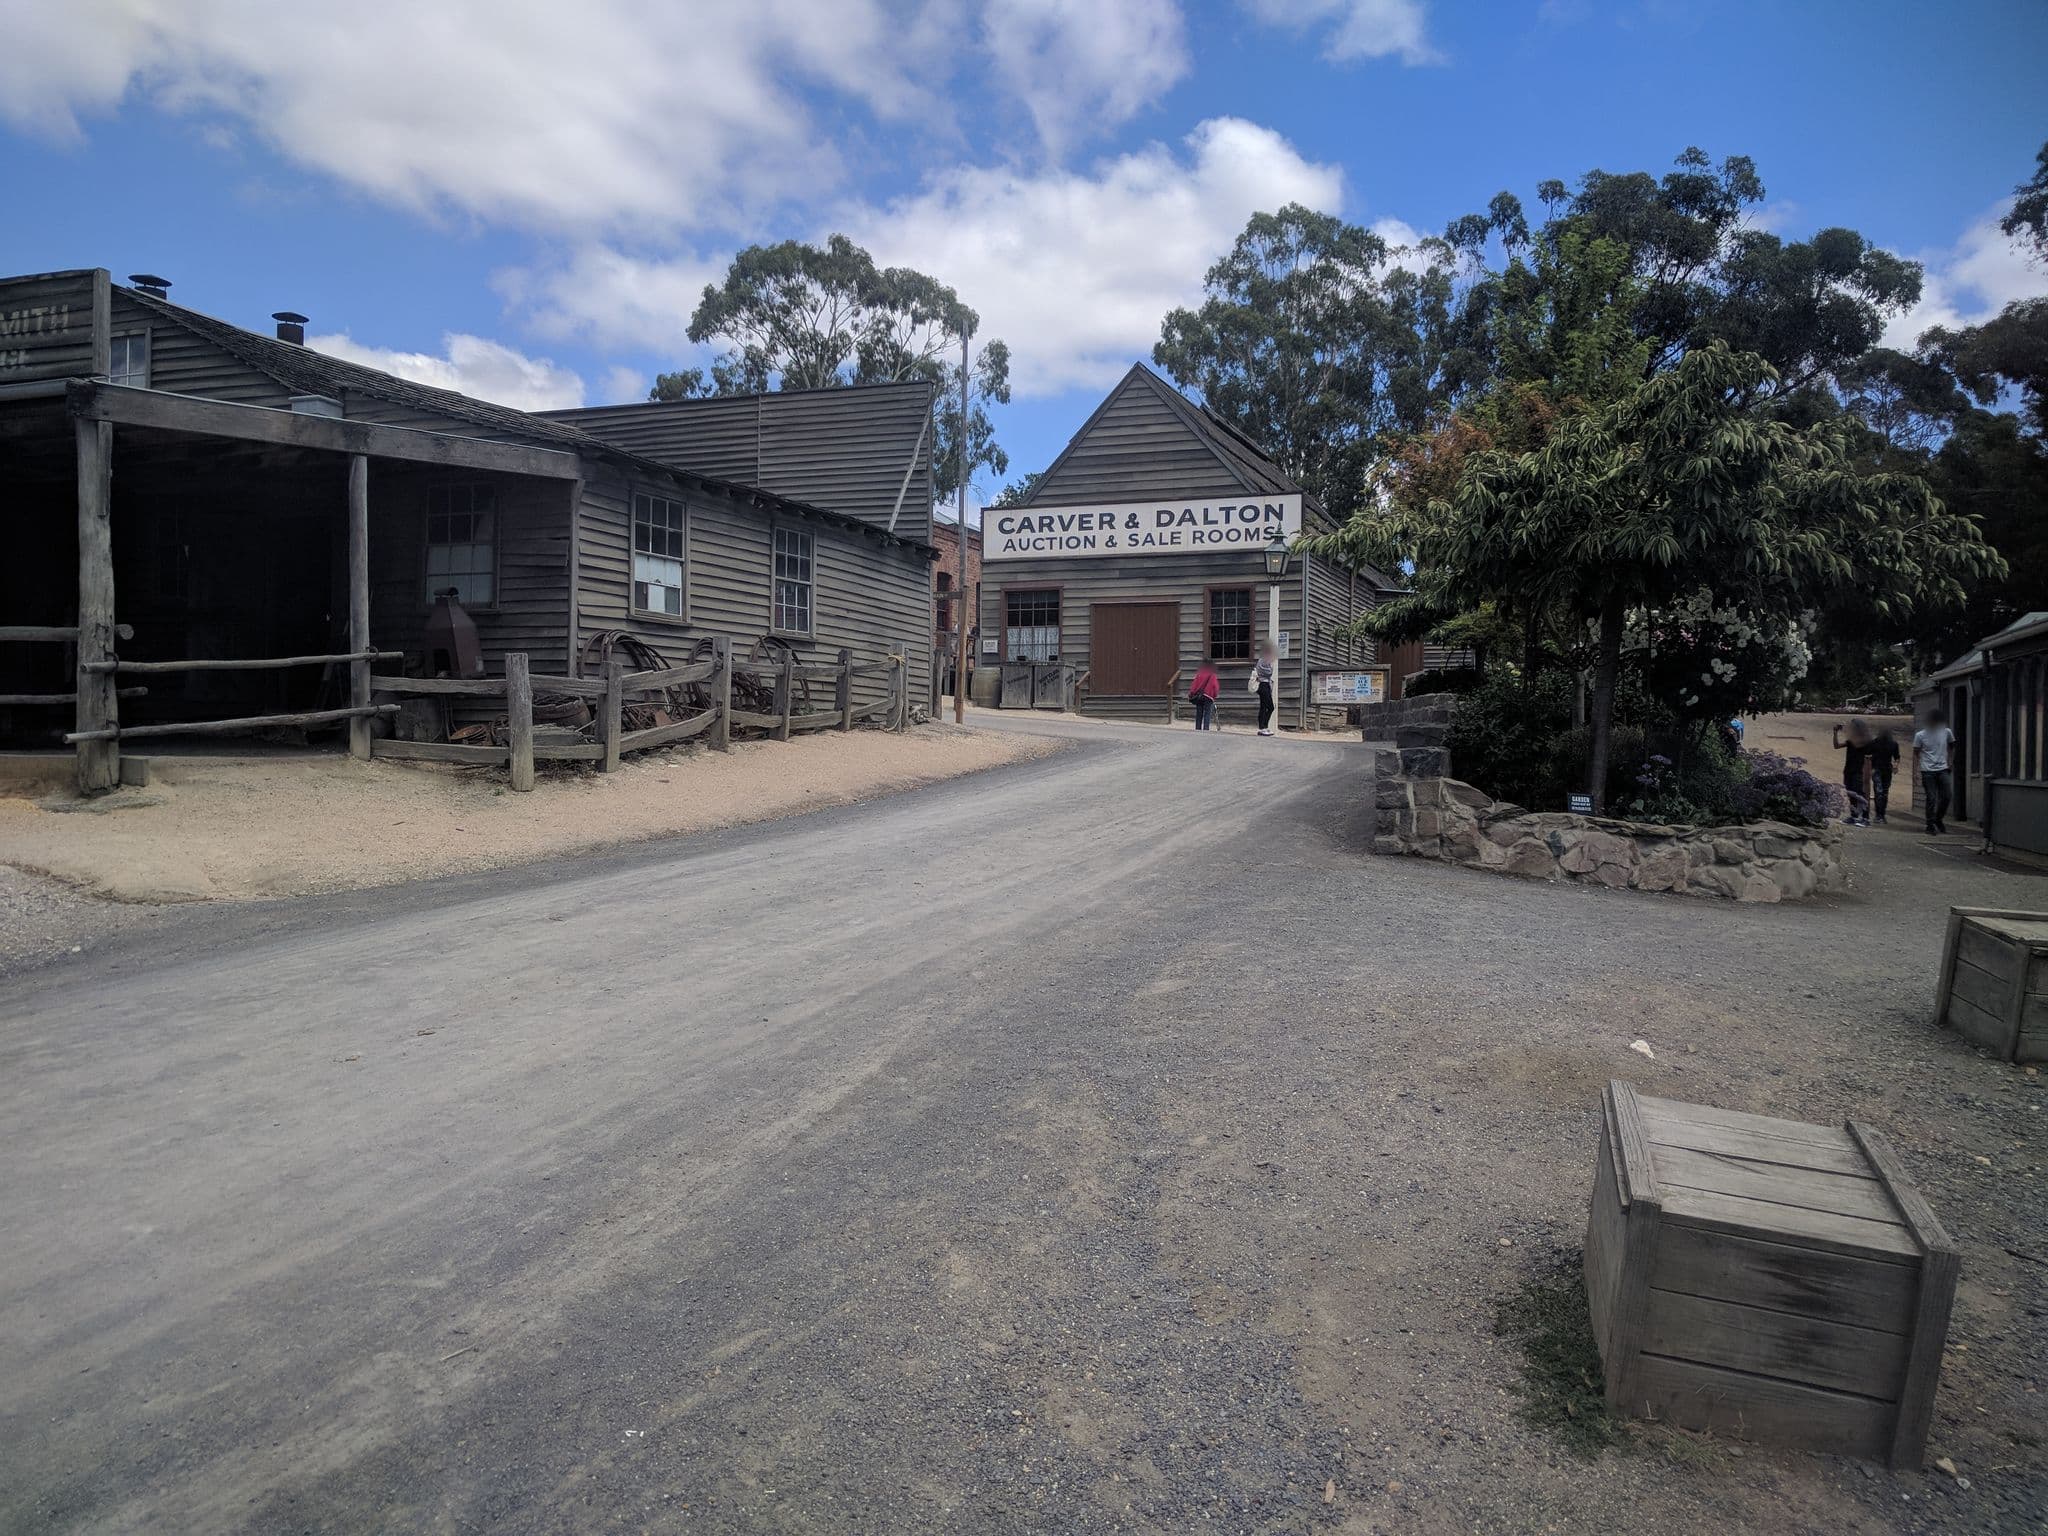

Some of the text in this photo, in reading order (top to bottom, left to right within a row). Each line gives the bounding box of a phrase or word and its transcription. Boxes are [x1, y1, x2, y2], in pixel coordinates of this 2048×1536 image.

[997, 503, 1284, 535] CARVER & DALTON
[1002, 526, 1275, 552] AUCTION & SALE ROOMS
